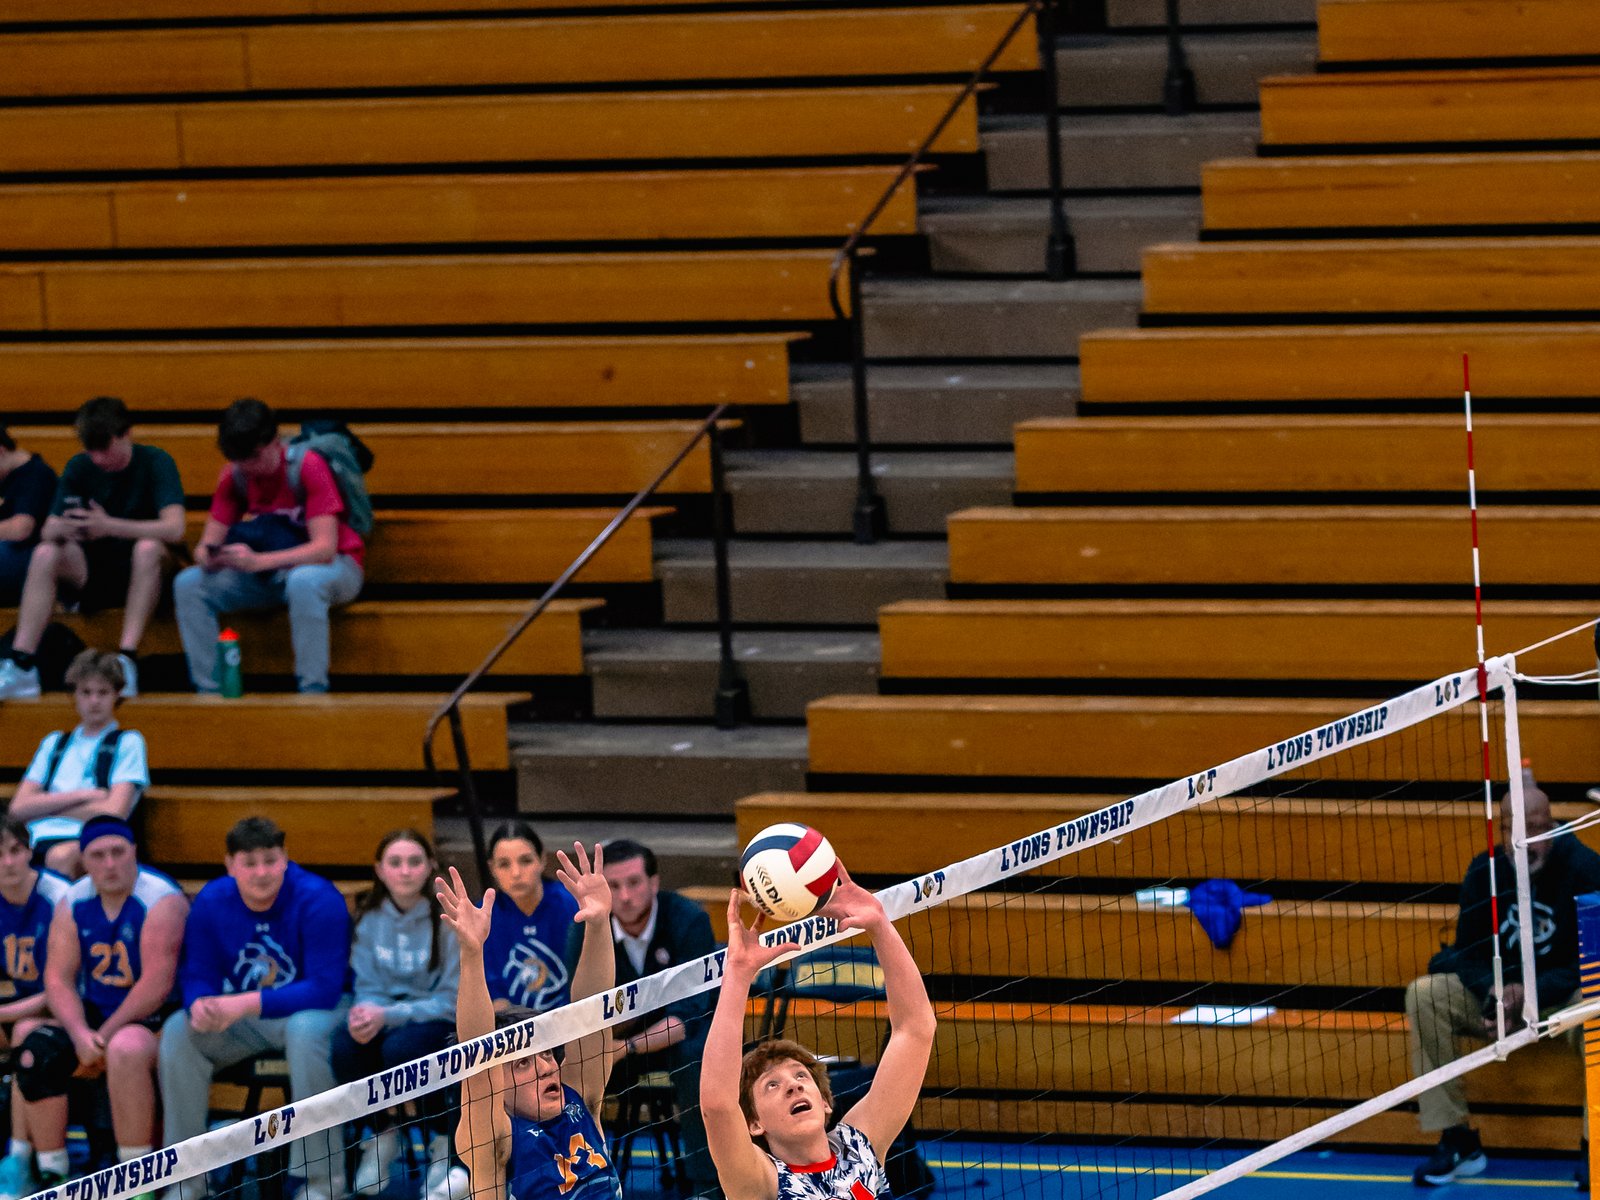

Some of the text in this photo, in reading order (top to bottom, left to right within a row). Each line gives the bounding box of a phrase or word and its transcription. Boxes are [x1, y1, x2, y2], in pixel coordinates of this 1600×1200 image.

[1266, 705, 1389, 771] LYONS TOWNSHIP
[1000, 799, 1135, 872] LYONS TOWNSHIP
[764, 916, 839, 948] TOWNSH
[367, 1020, 535, 1106] LYONS TOWNSHIP
[553, 1132, 608, 1196] 14
